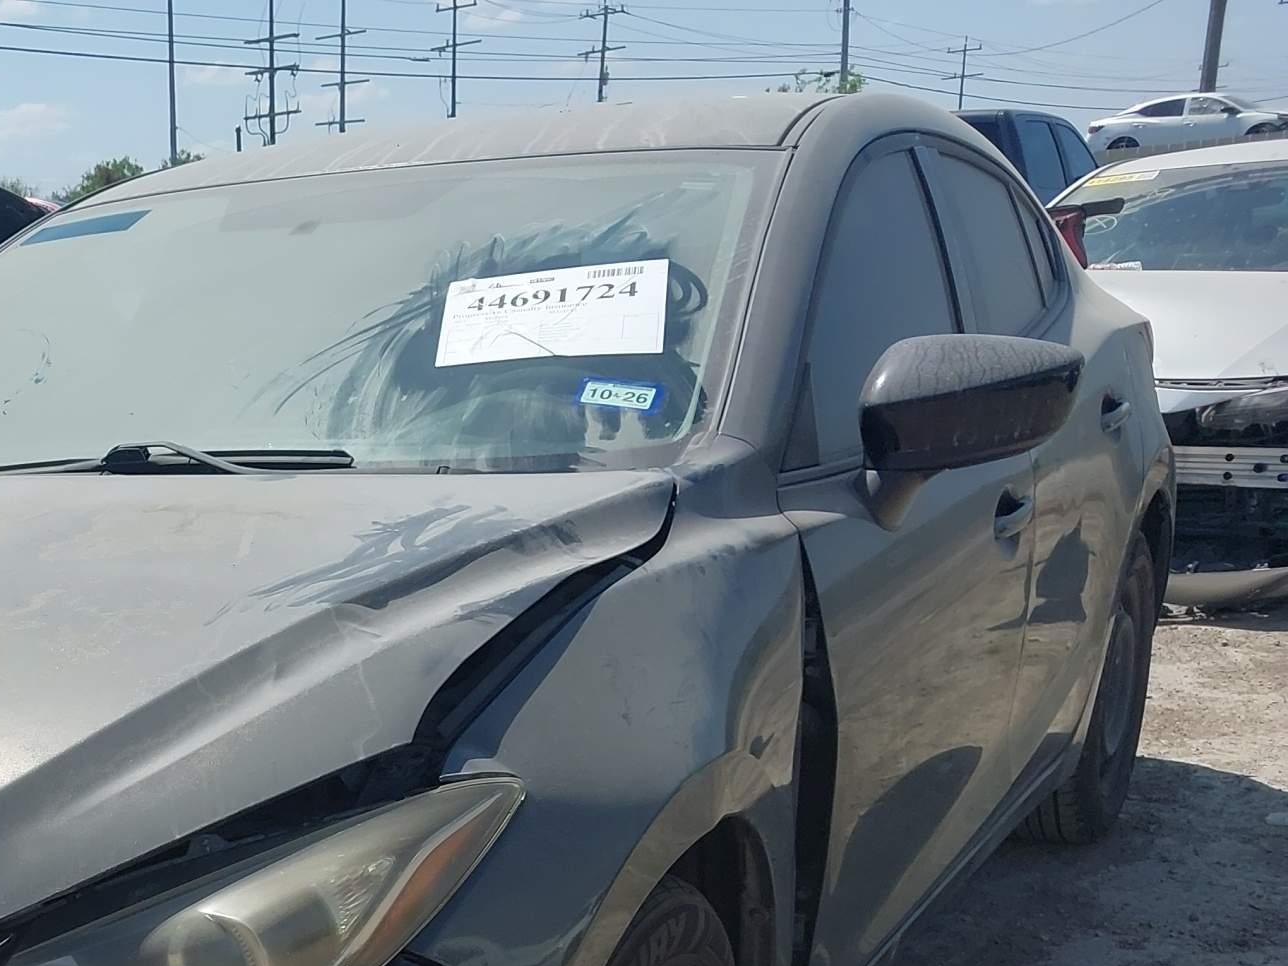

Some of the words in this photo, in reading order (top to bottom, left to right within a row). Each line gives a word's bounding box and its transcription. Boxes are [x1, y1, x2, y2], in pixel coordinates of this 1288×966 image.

[467, 281, 638, 311] 44691724
[589, 388, 613, 400] 10
[622, 391, 649, 404] 26
